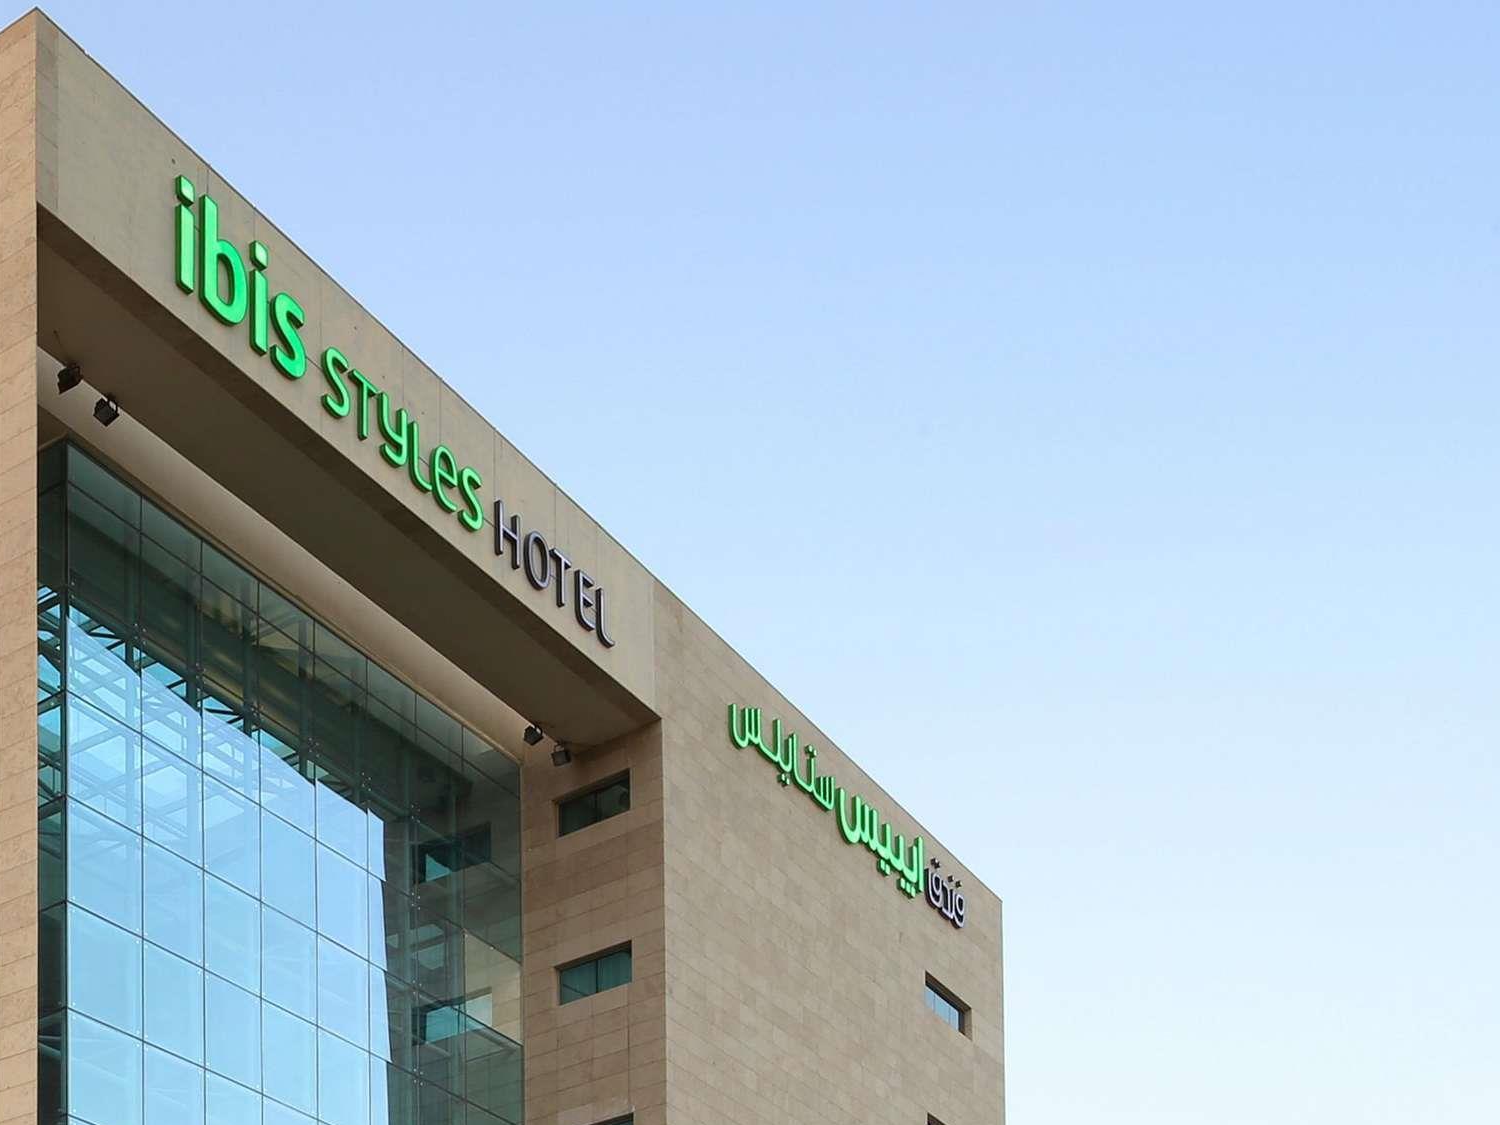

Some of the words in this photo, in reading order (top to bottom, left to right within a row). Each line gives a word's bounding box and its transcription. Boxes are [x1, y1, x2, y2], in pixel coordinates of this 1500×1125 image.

[175, 174, 306, 380] ibis
[494, 499, 616, 648] HOTEL
[924, 857, 964, 929] فندق
